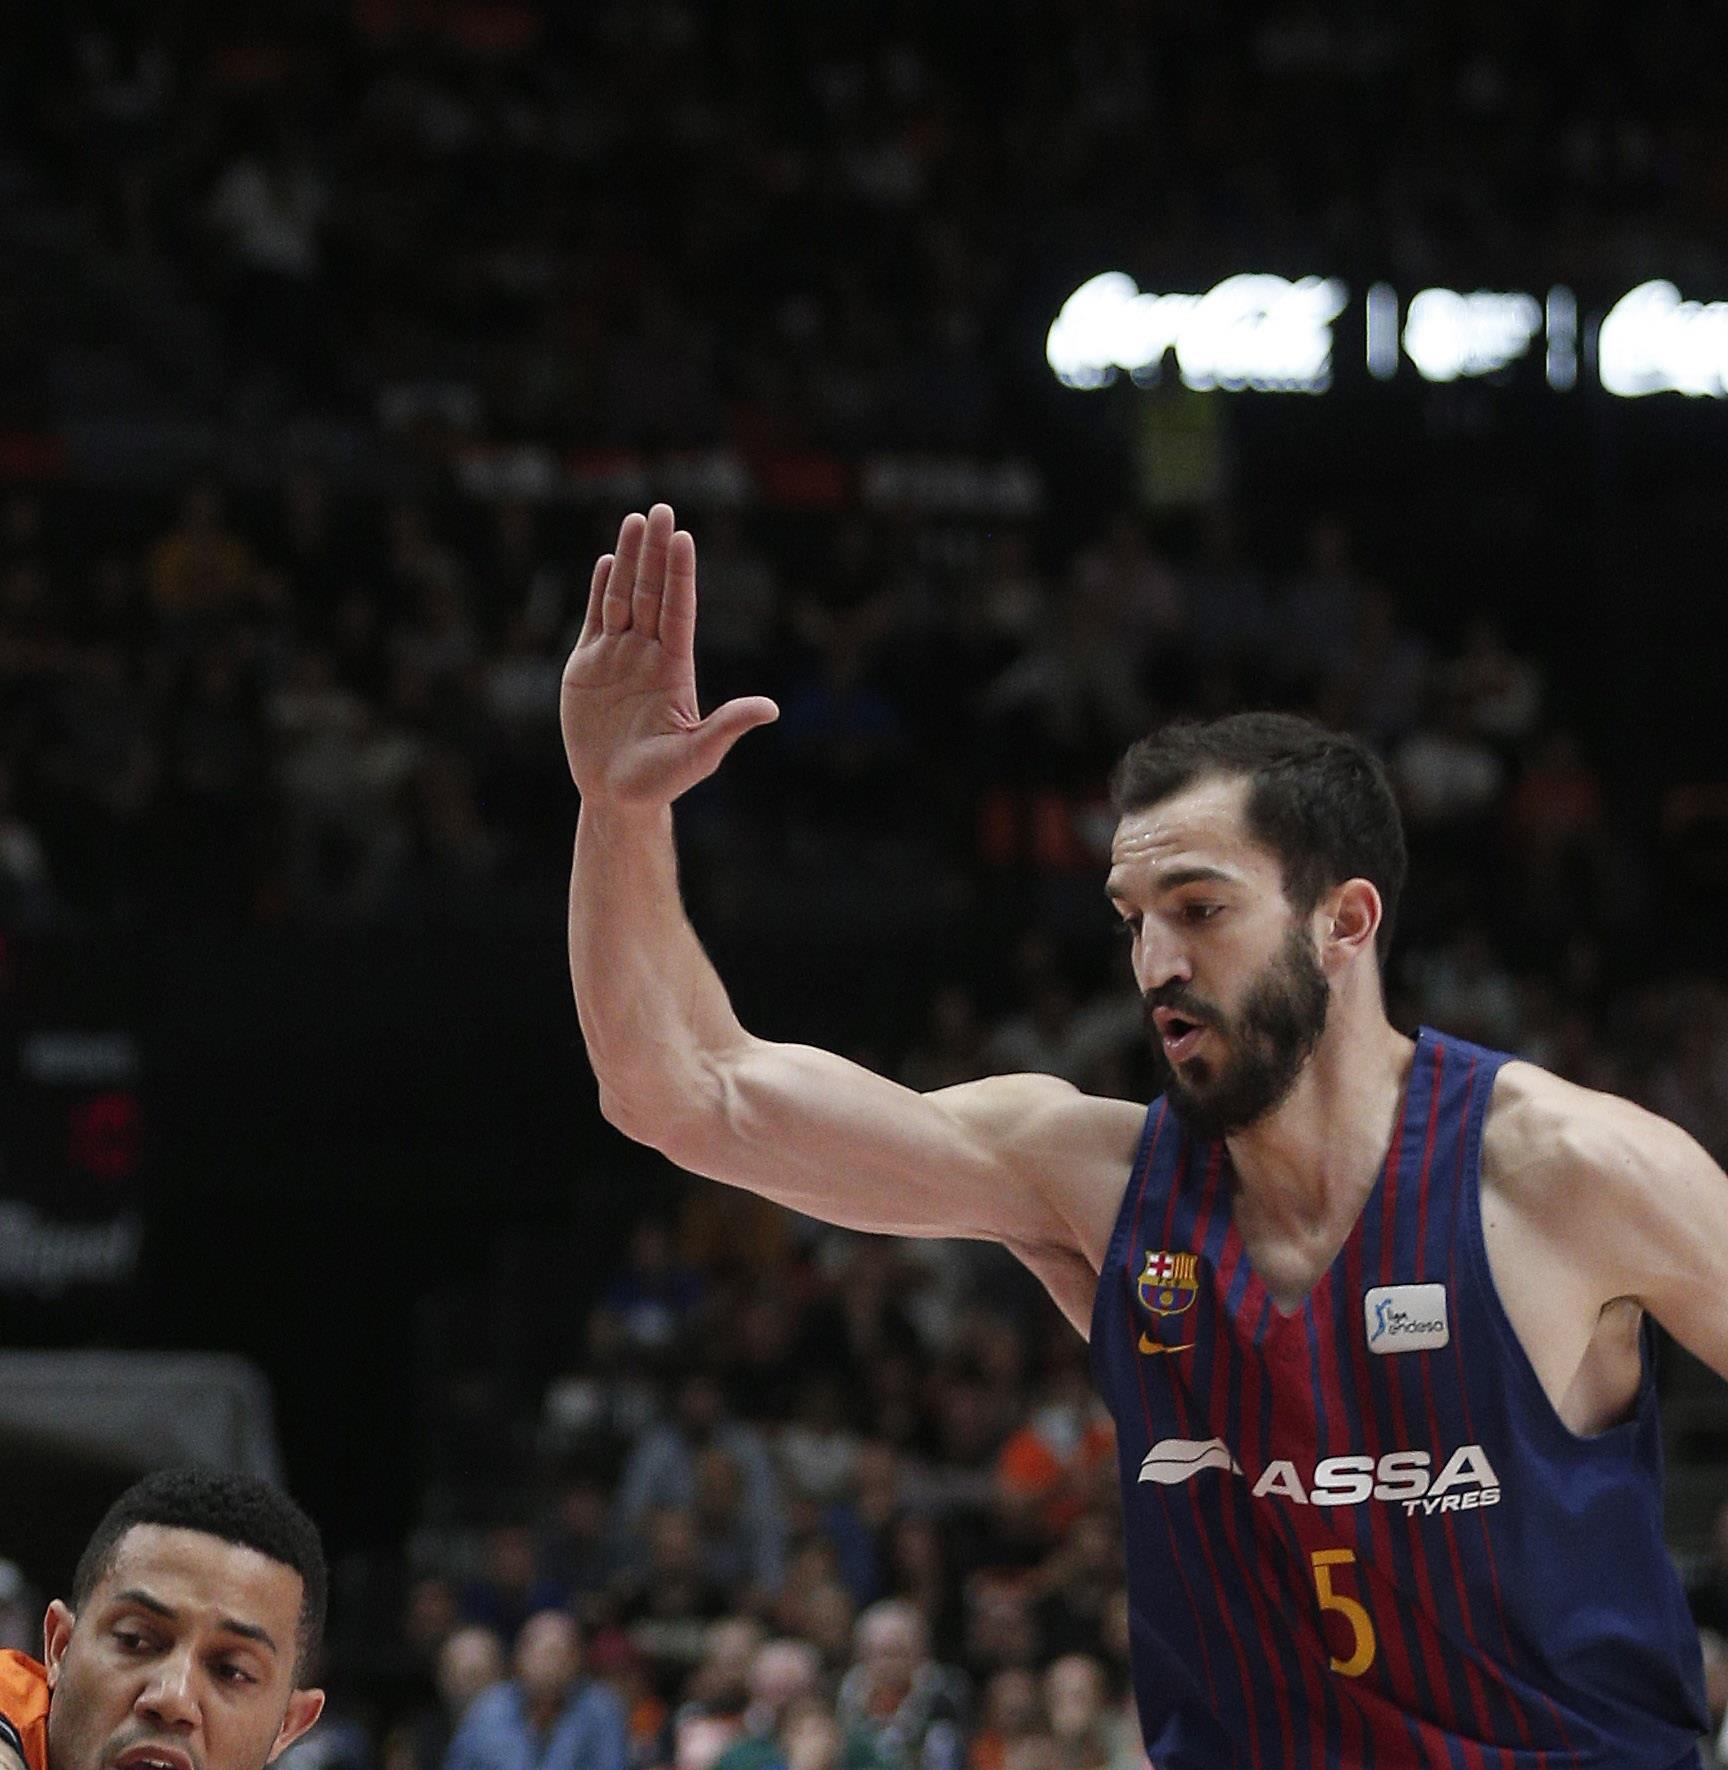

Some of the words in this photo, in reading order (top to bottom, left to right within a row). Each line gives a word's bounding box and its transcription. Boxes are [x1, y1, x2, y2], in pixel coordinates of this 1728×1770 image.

[1252, 1445, 1500, 1506] ASSA
[1402, 1488, 1501, 1517] TYRES
[1311, 1549, 1376, 1677] 5
